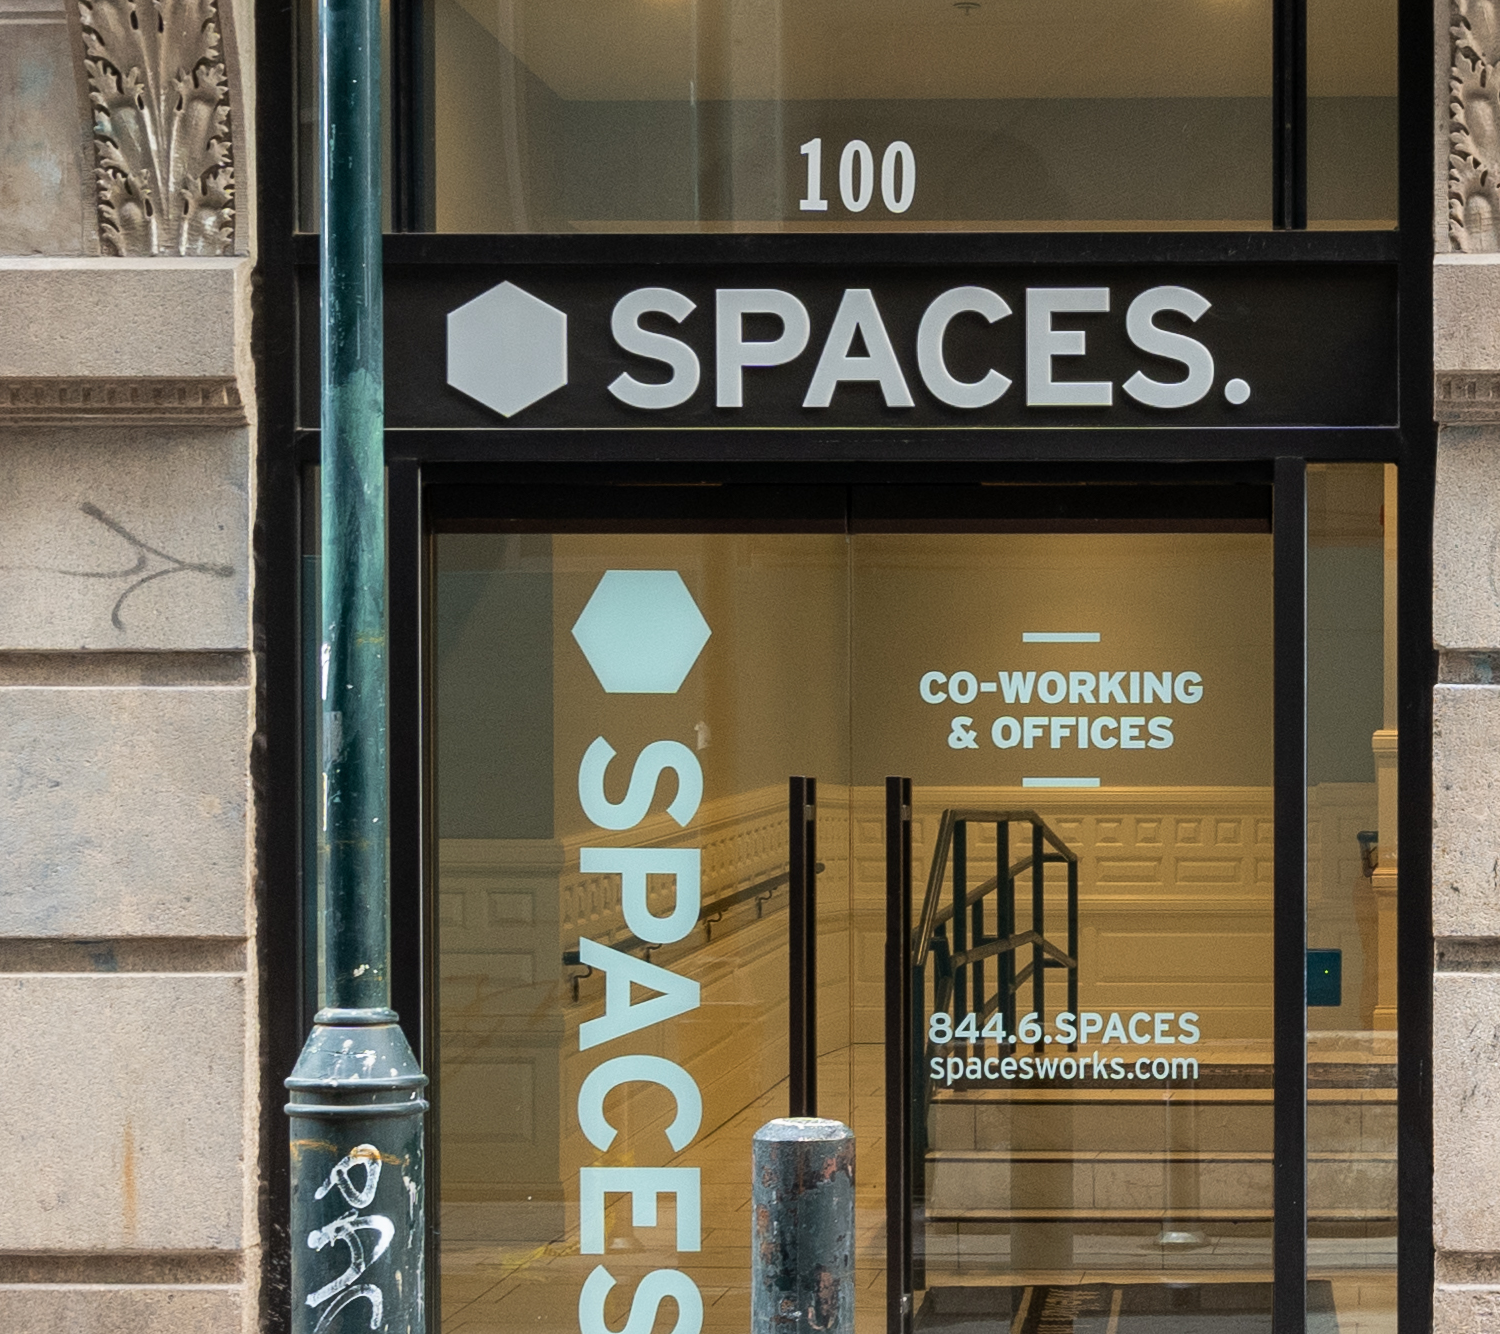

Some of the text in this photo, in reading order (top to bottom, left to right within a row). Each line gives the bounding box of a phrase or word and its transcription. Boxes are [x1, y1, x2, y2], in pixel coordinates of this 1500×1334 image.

[799, 137, 916, 213] 100
[607, 285, 1252, 410] SPACES.
[919, 670, 1204, 704] CO-WORKING
[947, 716, 1174, 750] & OFFICES
[928, 1011, 1201, 1045] 844.6.SPACES
[930, 1050, 1199, 1086] spacesworks.com
